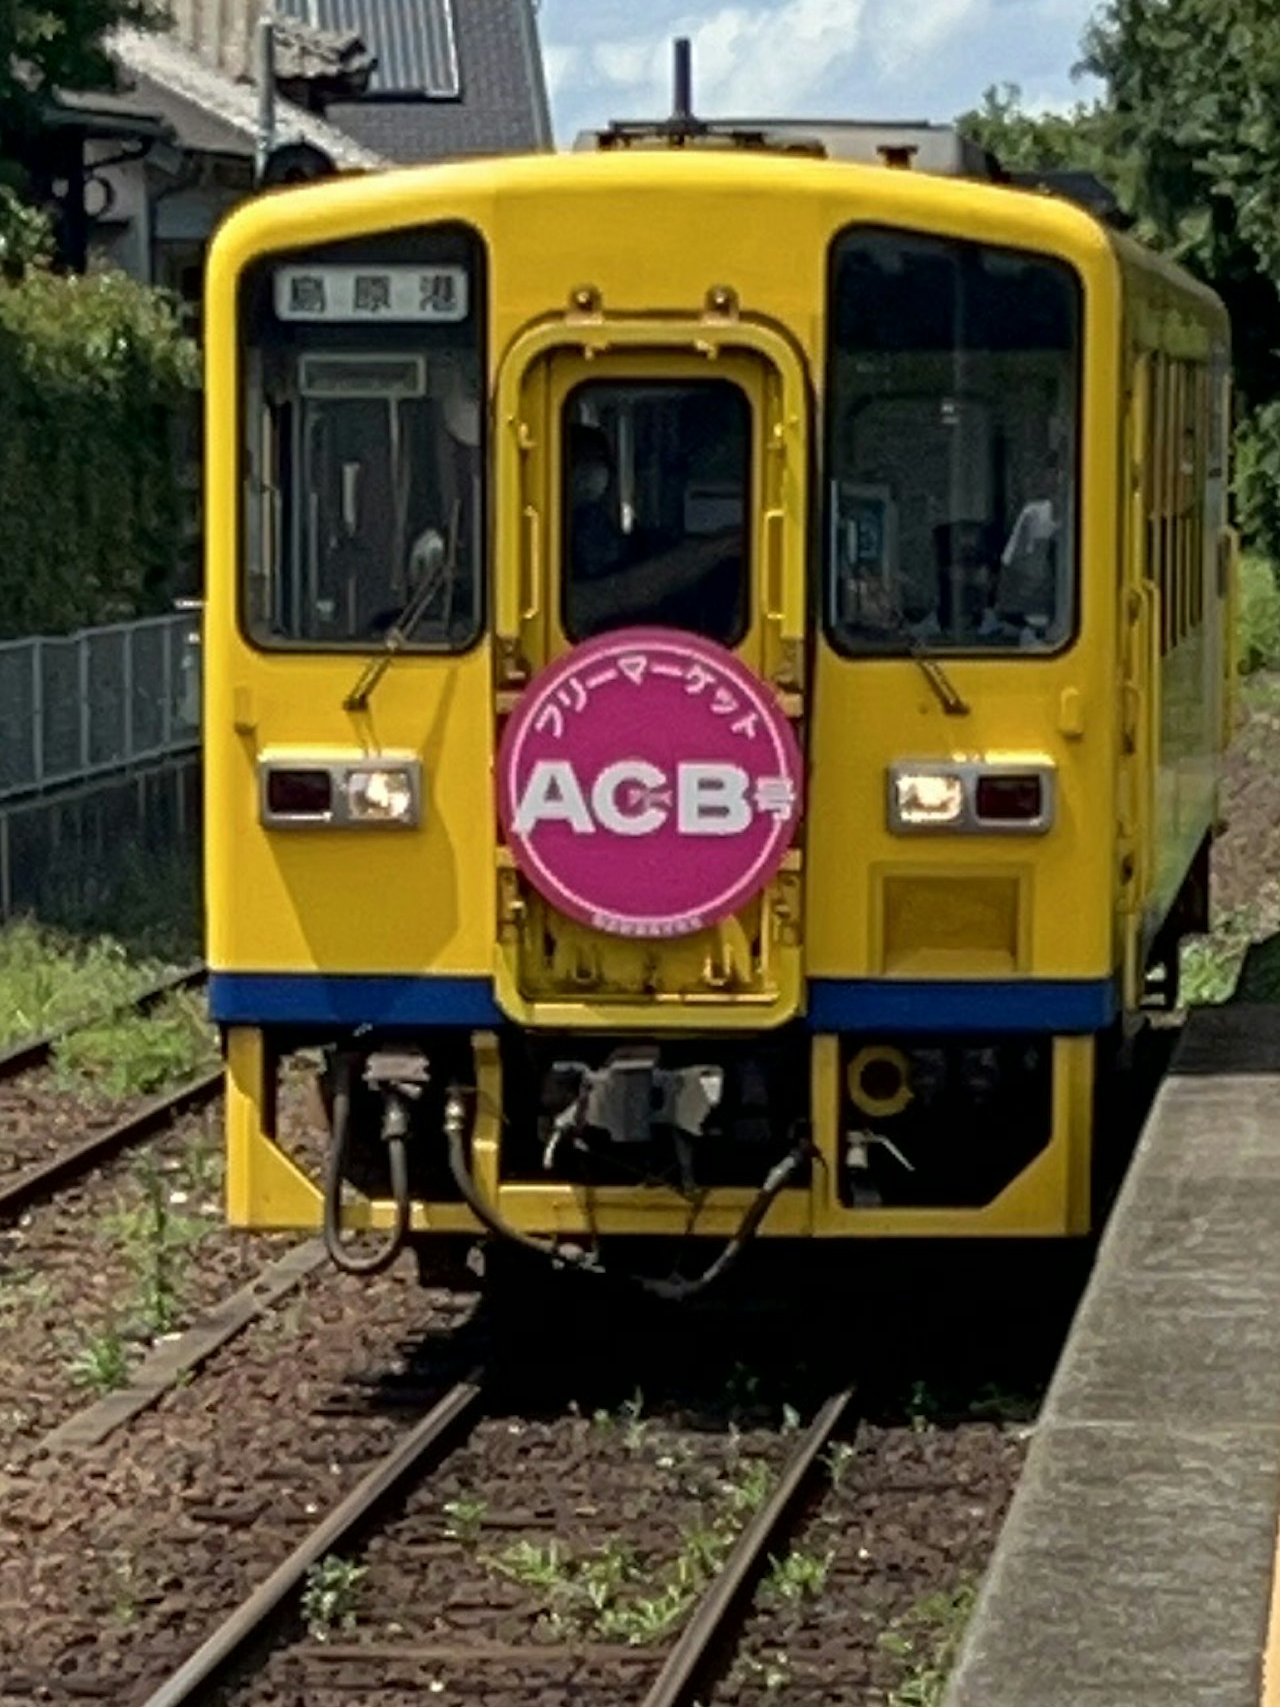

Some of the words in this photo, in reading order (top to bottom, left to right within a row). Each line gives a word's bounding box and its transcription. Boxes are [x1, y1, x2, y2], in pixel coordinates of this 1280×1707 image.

[289, 274, 458, 313] 島原港
[534, 654, 760, 739] フリーマーケット
